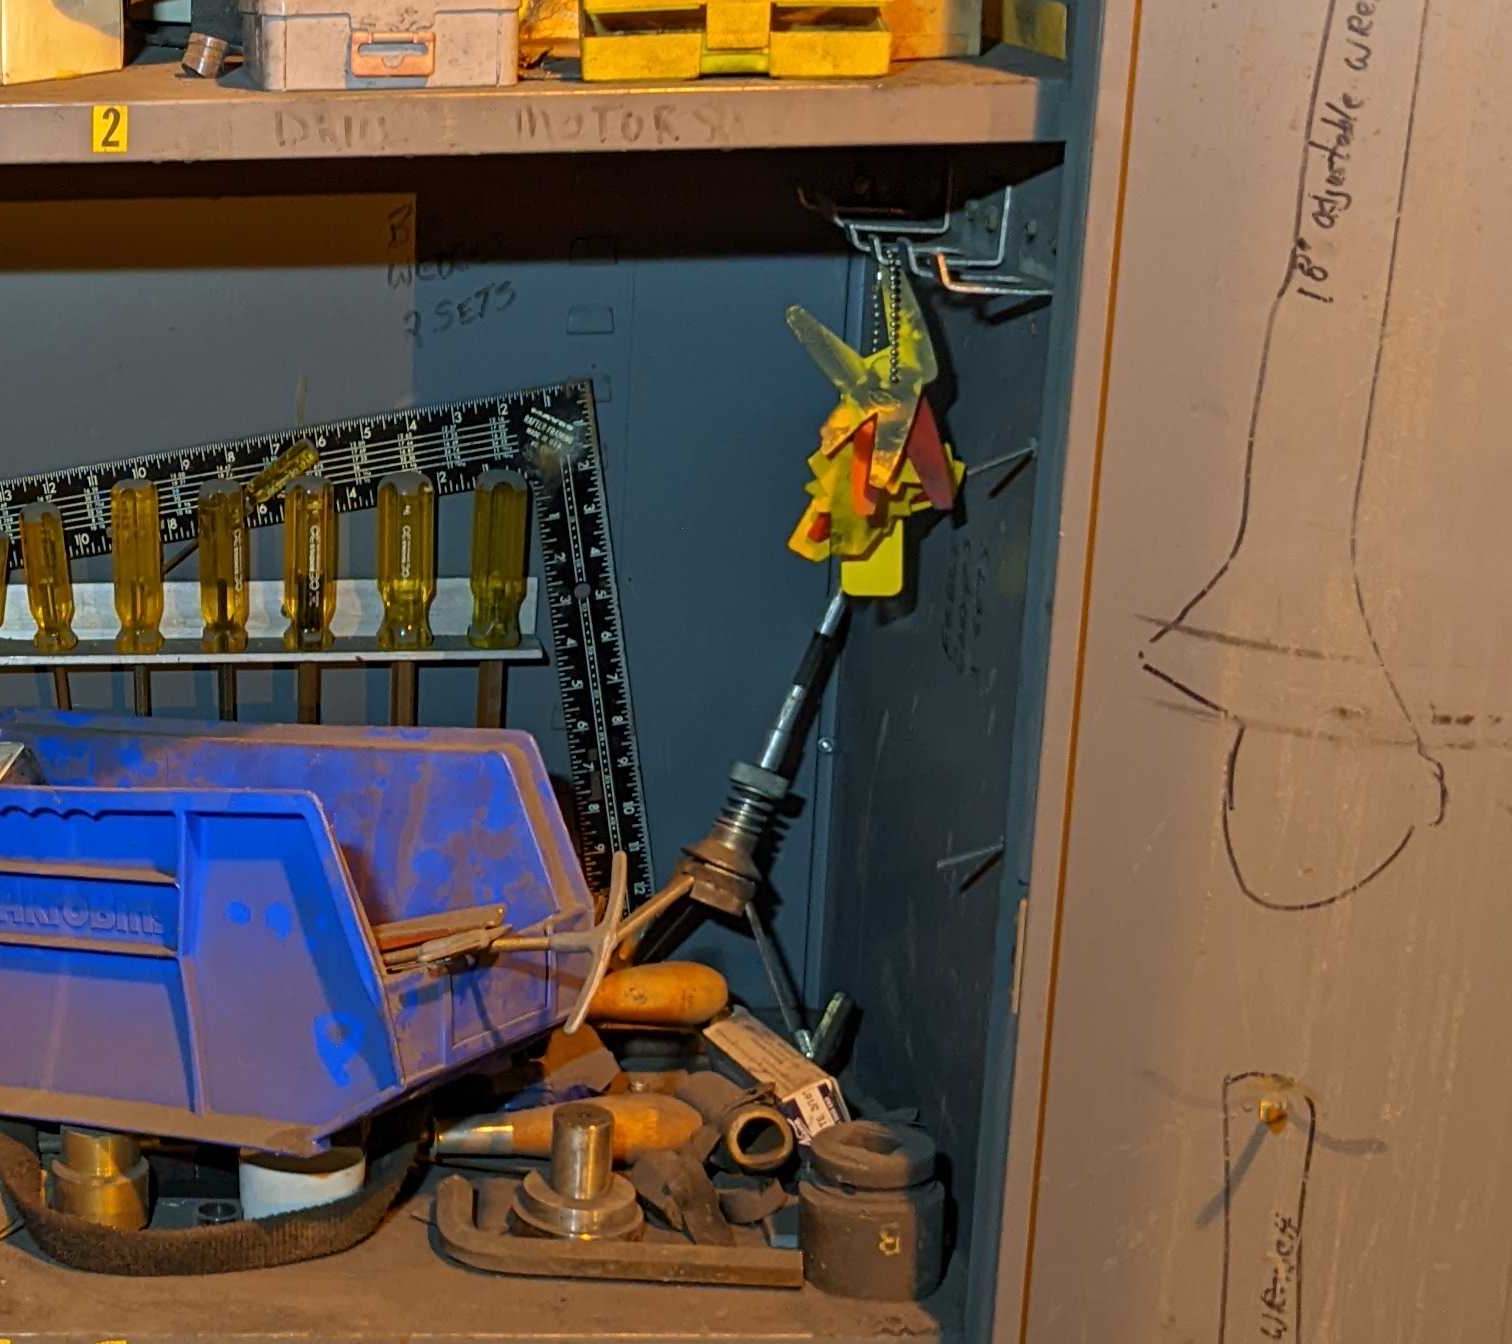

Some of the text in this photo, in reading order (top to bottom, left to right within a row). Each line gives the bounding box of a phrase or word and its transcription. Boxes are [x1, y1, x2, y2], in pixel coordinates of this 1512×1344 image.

[101, 109, 121, 147] 2
[432, 279, 517, 334] SETS
[0, 490, 13, 502] 13
[43, 483, 57, 495] 12
[132, 468, 147, 479] 10
